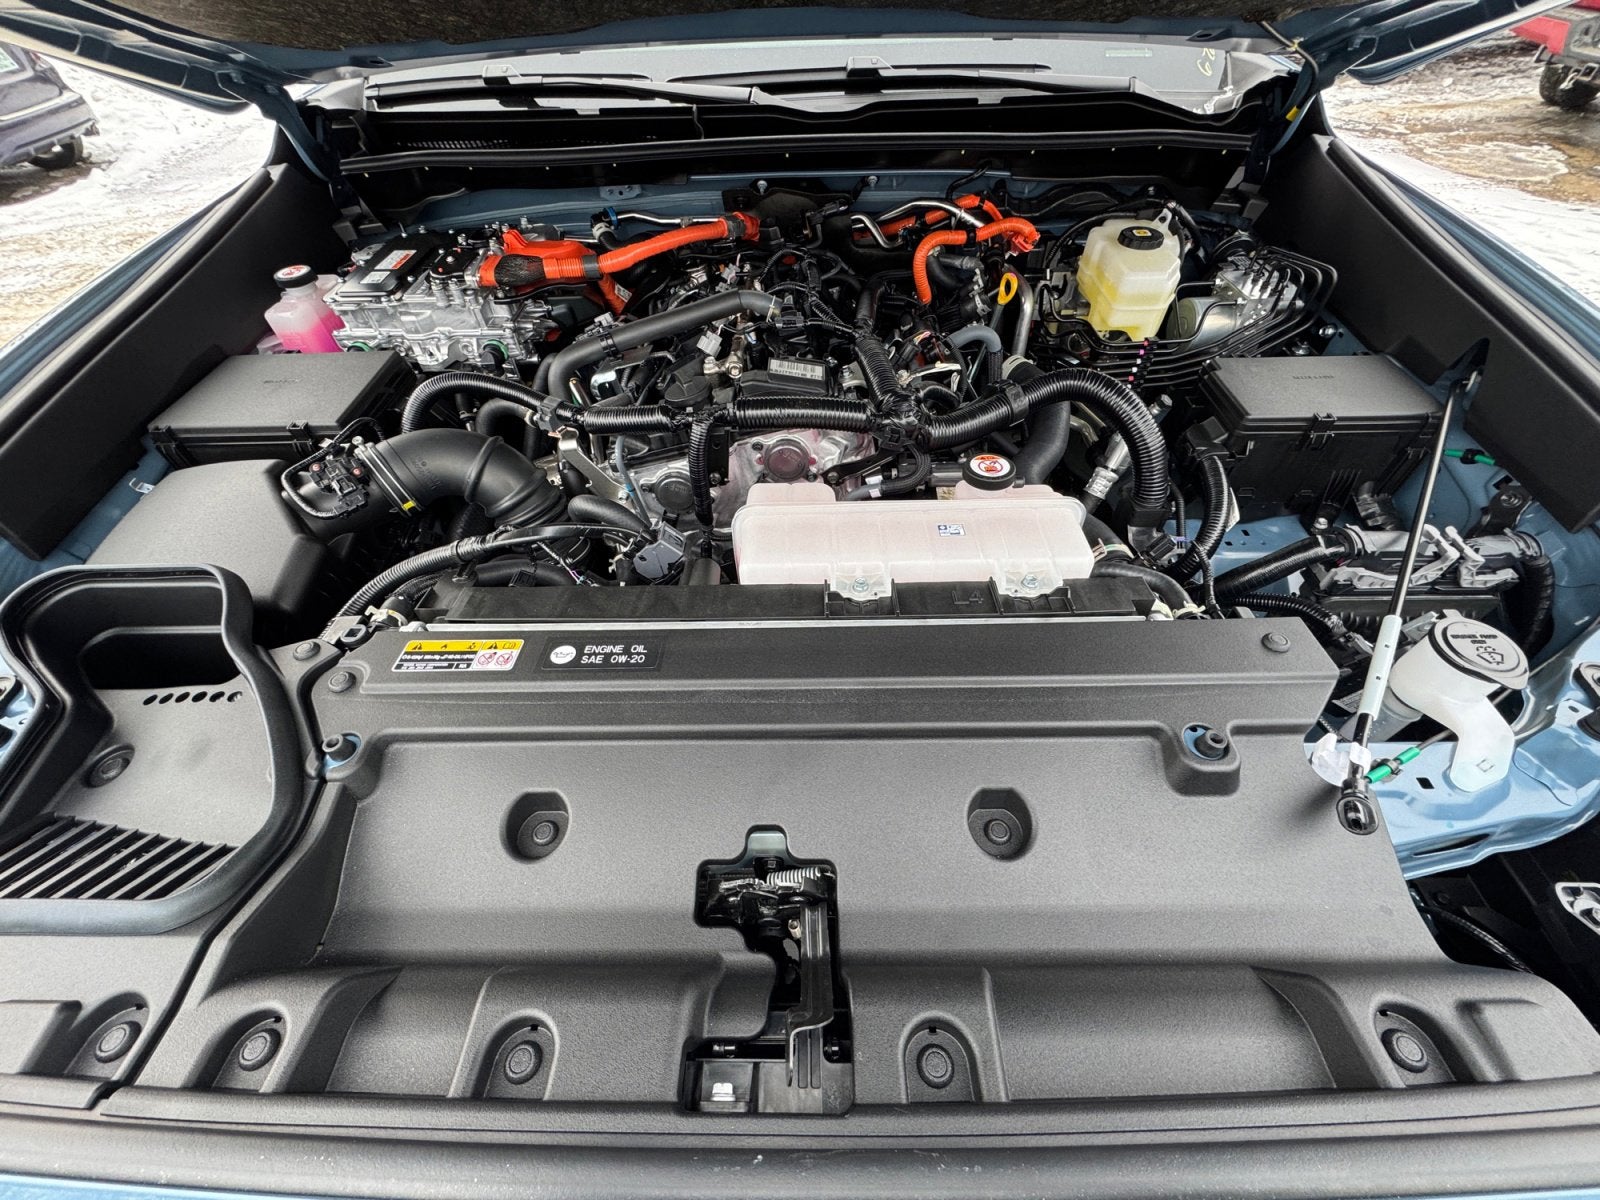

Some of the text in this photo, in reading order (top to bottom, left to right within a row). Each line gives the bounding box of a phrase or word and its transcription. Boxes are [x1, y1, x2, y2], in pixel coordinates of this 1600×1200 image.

[583, 644, 648, 654] ENGINE OIL
[580, 654, 645, 664] SAE 0W-20
